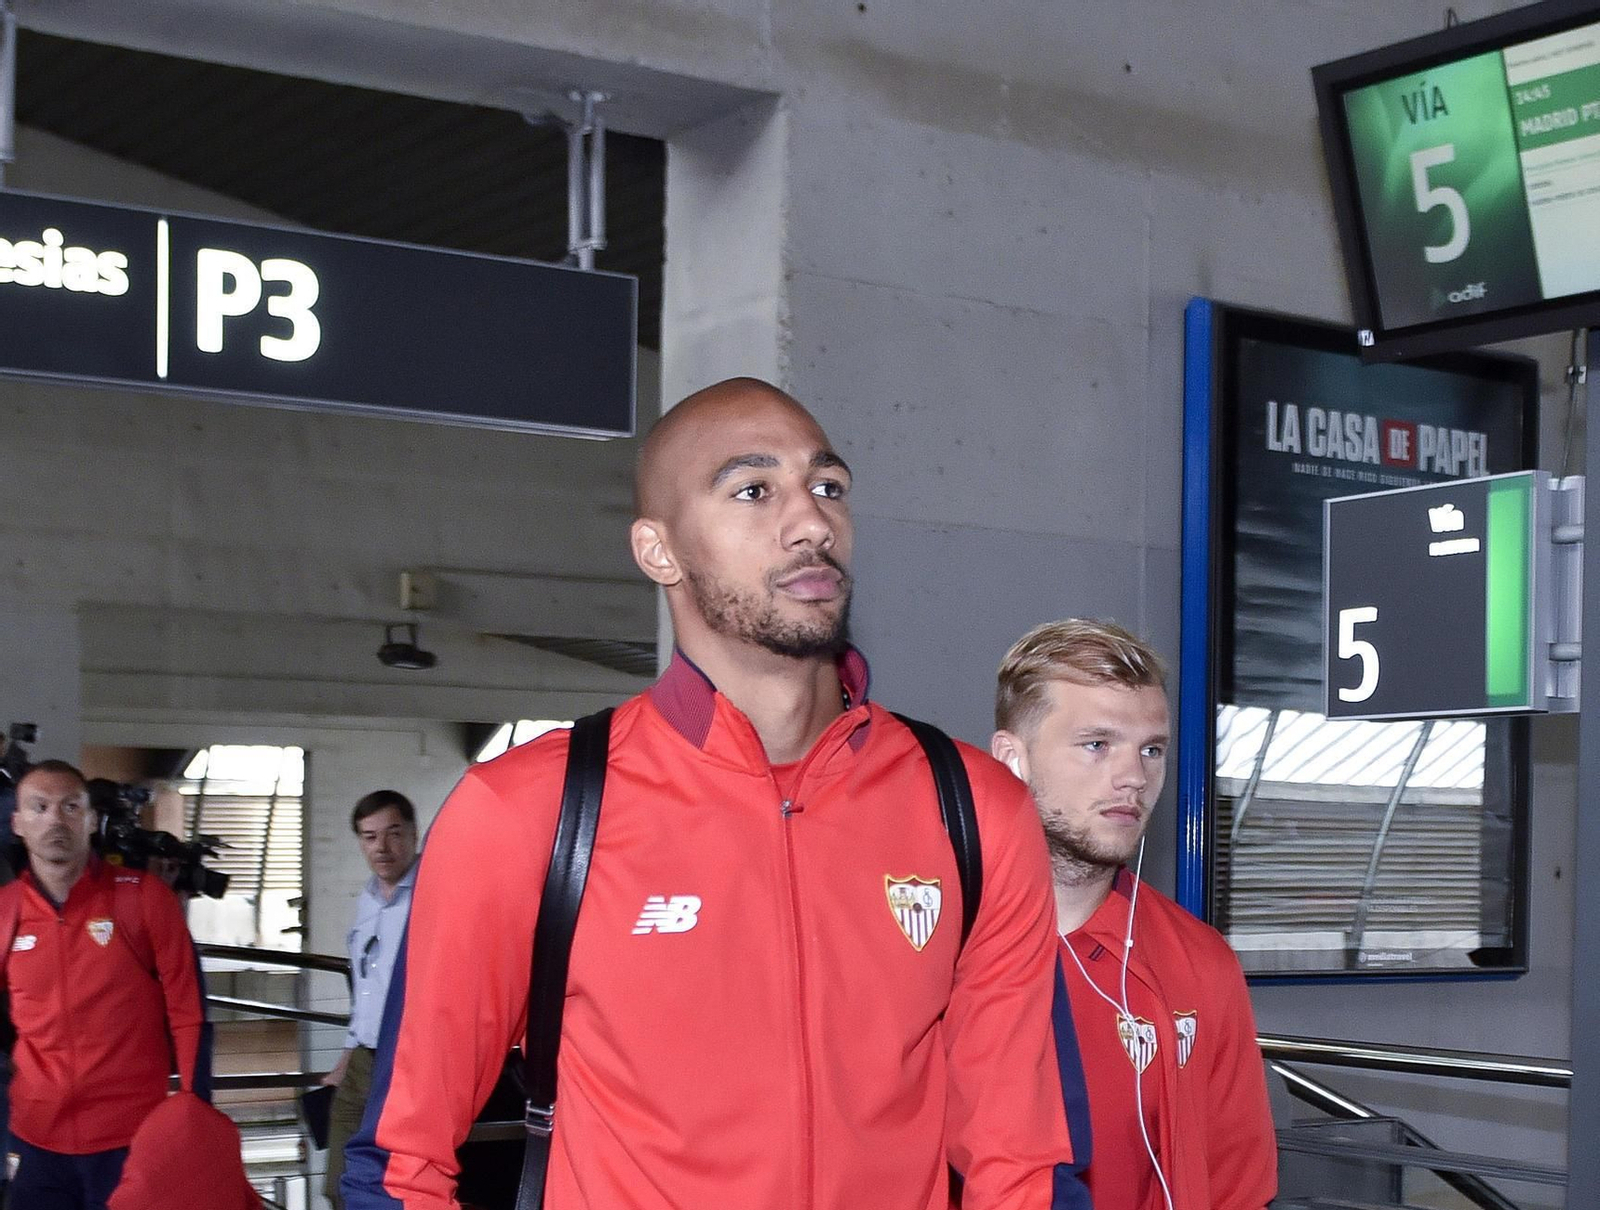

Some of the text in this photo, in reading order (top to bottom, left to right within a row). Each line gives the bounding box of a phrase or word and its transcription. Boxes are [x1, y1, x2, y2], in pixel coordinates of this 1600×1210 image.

[1401, 81, 1449, 126] VÍA
[1520, 107, 1579, 137] MADRID
[1409, 143, 1471, 264] 5
[197, 248, 322, 362] P3
[1266, 401, 1491, 477] LA CASA DE PAPEL
[1338, 606, 1380, 703] 5
[631, 896, 702, 935] NB
